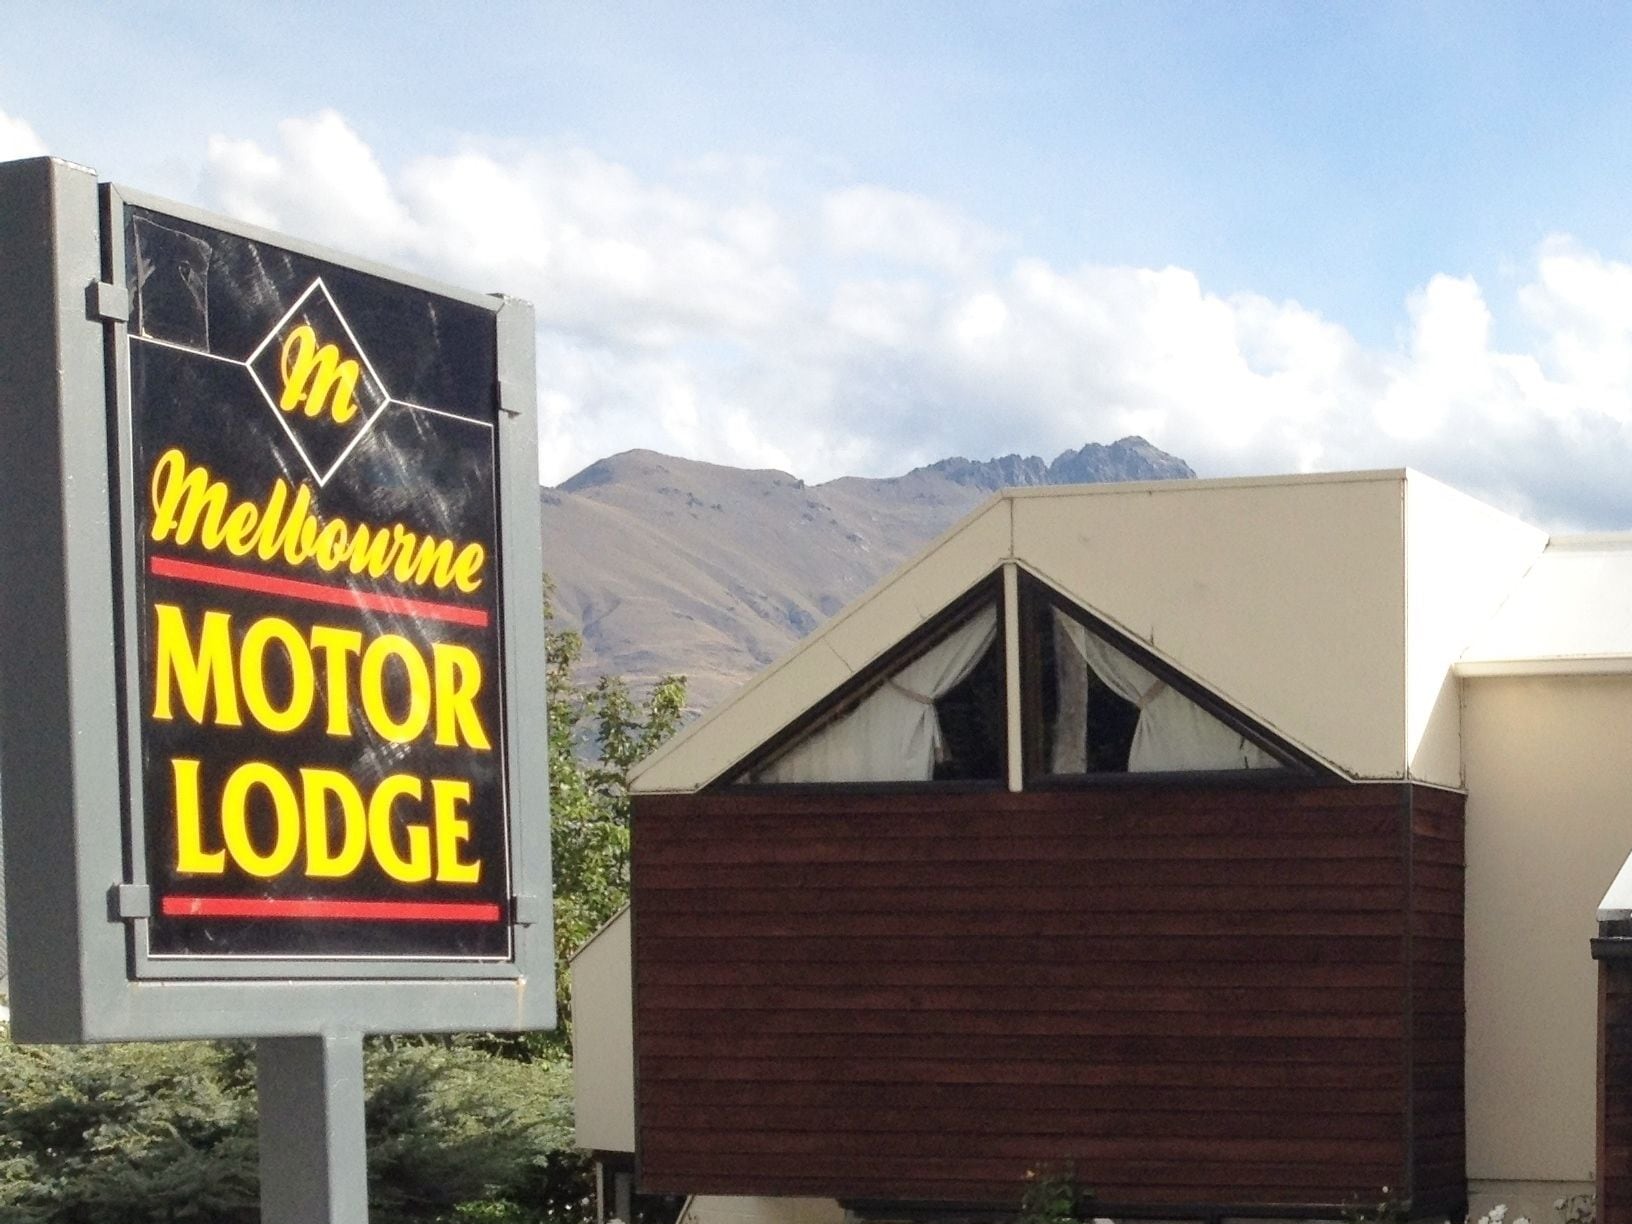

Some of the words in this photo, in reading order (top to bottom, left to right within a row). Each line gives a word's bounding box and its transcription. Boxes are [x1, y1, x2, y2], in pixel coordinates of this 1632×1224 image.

[150, 447, 487, 595] Melbourne
[152, 602, 492, 751] MOTOR
[171, 758, 482, 885] LODGE
